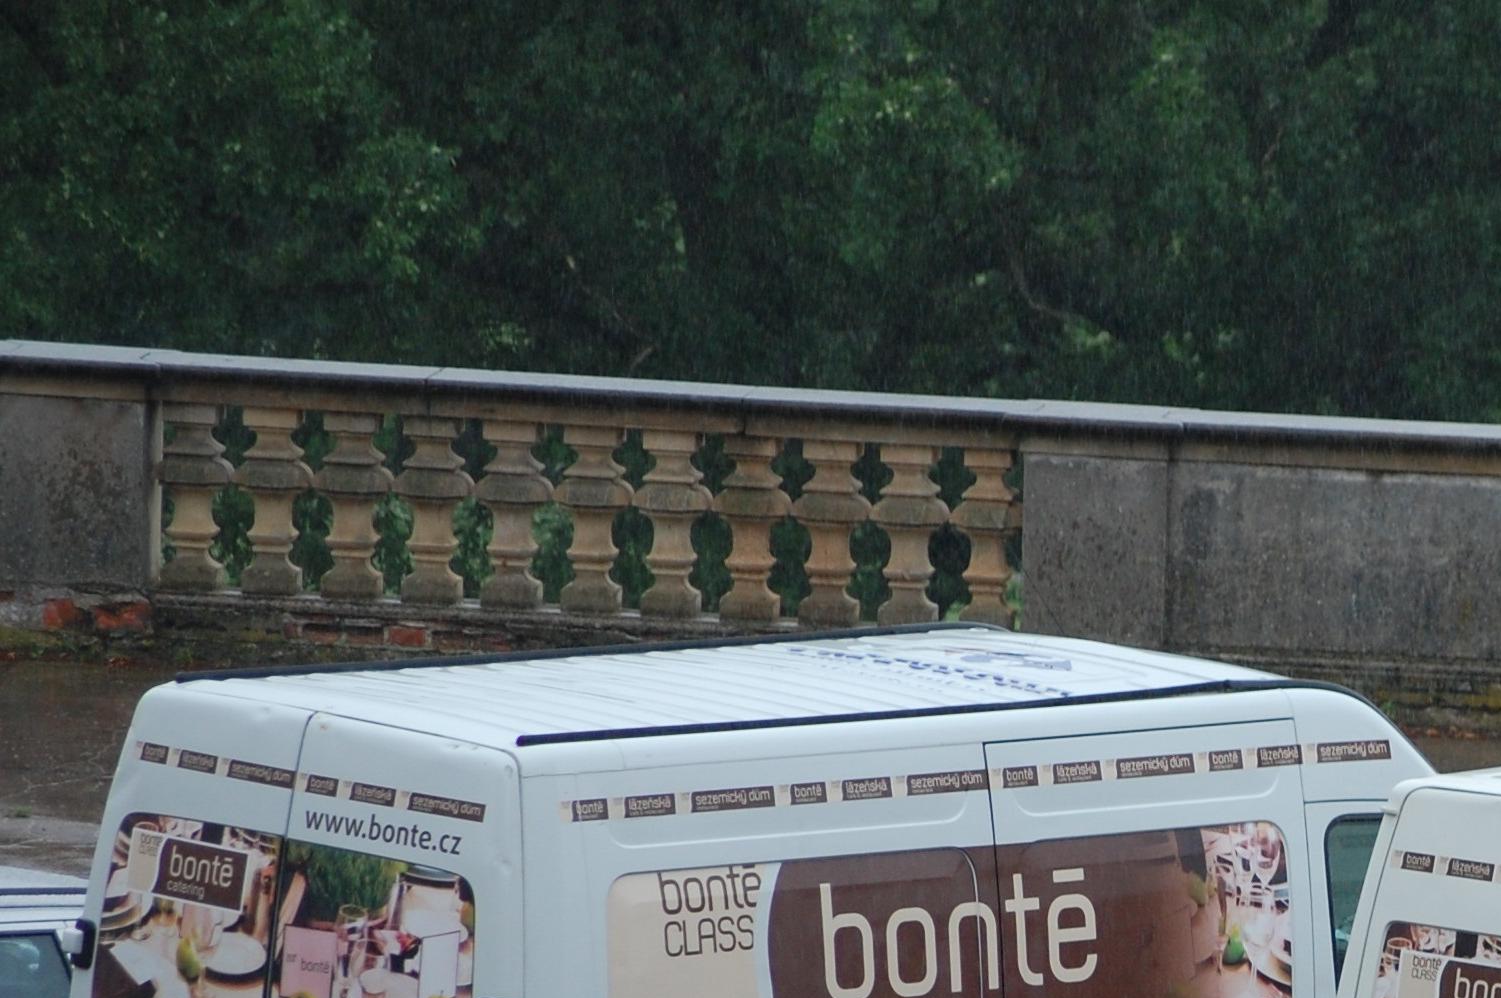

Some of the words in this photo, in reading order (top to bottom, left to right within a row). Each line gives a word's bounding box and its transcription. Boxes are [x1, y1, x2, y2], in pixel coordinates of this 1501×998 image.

[305, 810, 462, 855] www.bonte.cz
[166, 879, 205, 899] catering
[663, 914, 755, 958] CLASS
